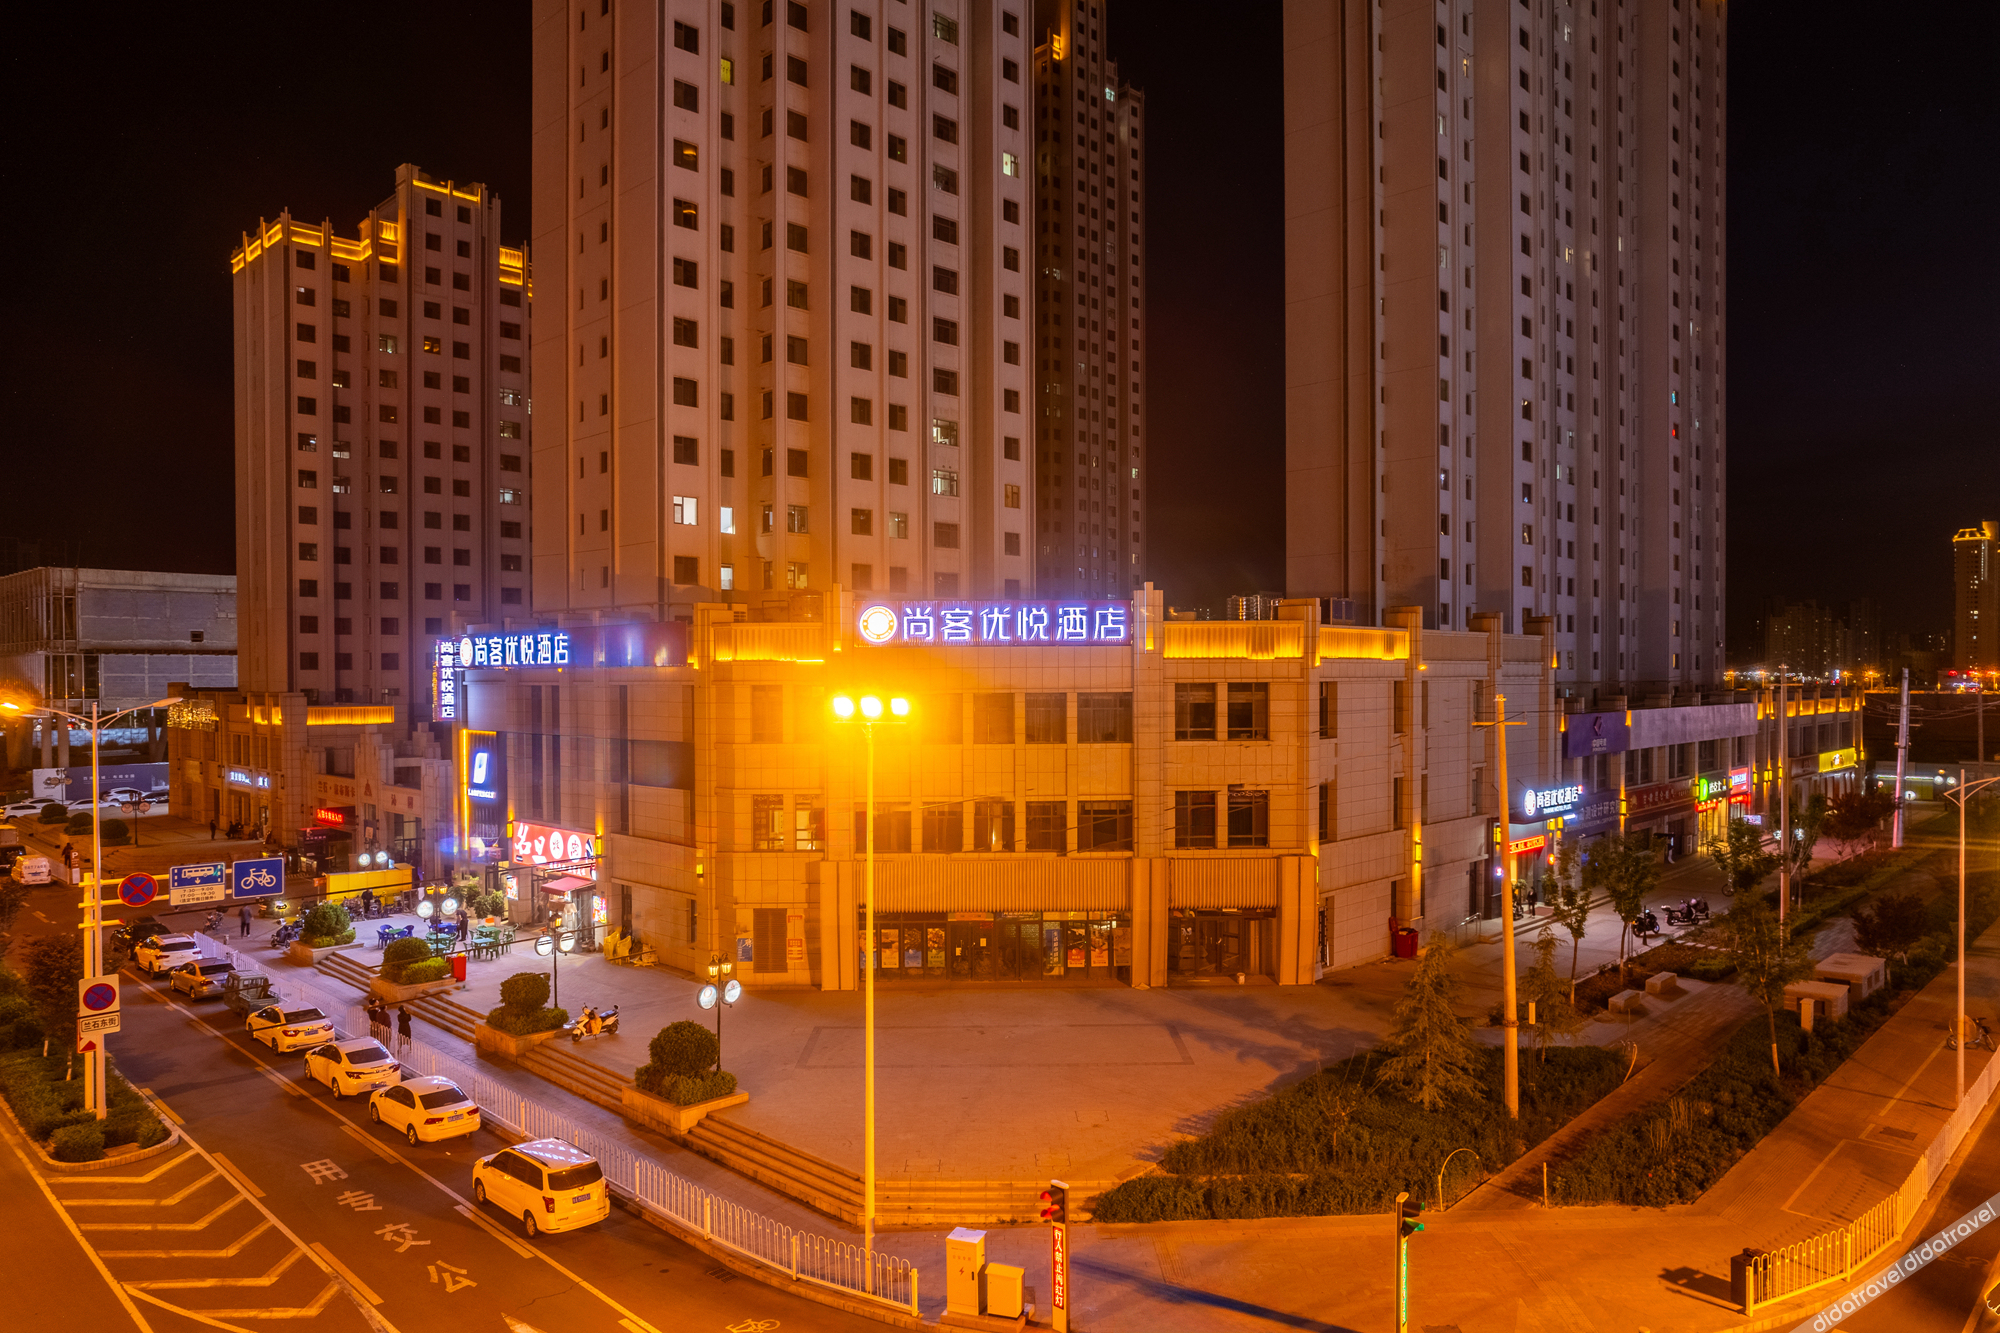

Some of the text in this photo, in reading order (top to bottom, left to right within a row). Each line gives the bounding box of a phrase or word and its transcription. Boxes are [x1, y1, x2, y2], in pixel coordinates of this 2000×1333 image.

[902, 606, 1127, 641] 尚客优悦酒店
[474, 633, 569, 666] 尚客优悦酒店
[440, 641, 455, 718] 尚客优悦酒店
[1536, 786, 1579, 809] 尚客优悦酒店
[72, 851, 79, 859] P
[84, 1017, 117, 1030] 兰石东街
[1054, 1229, 1063, 1307] 行人禁止闯红灯
